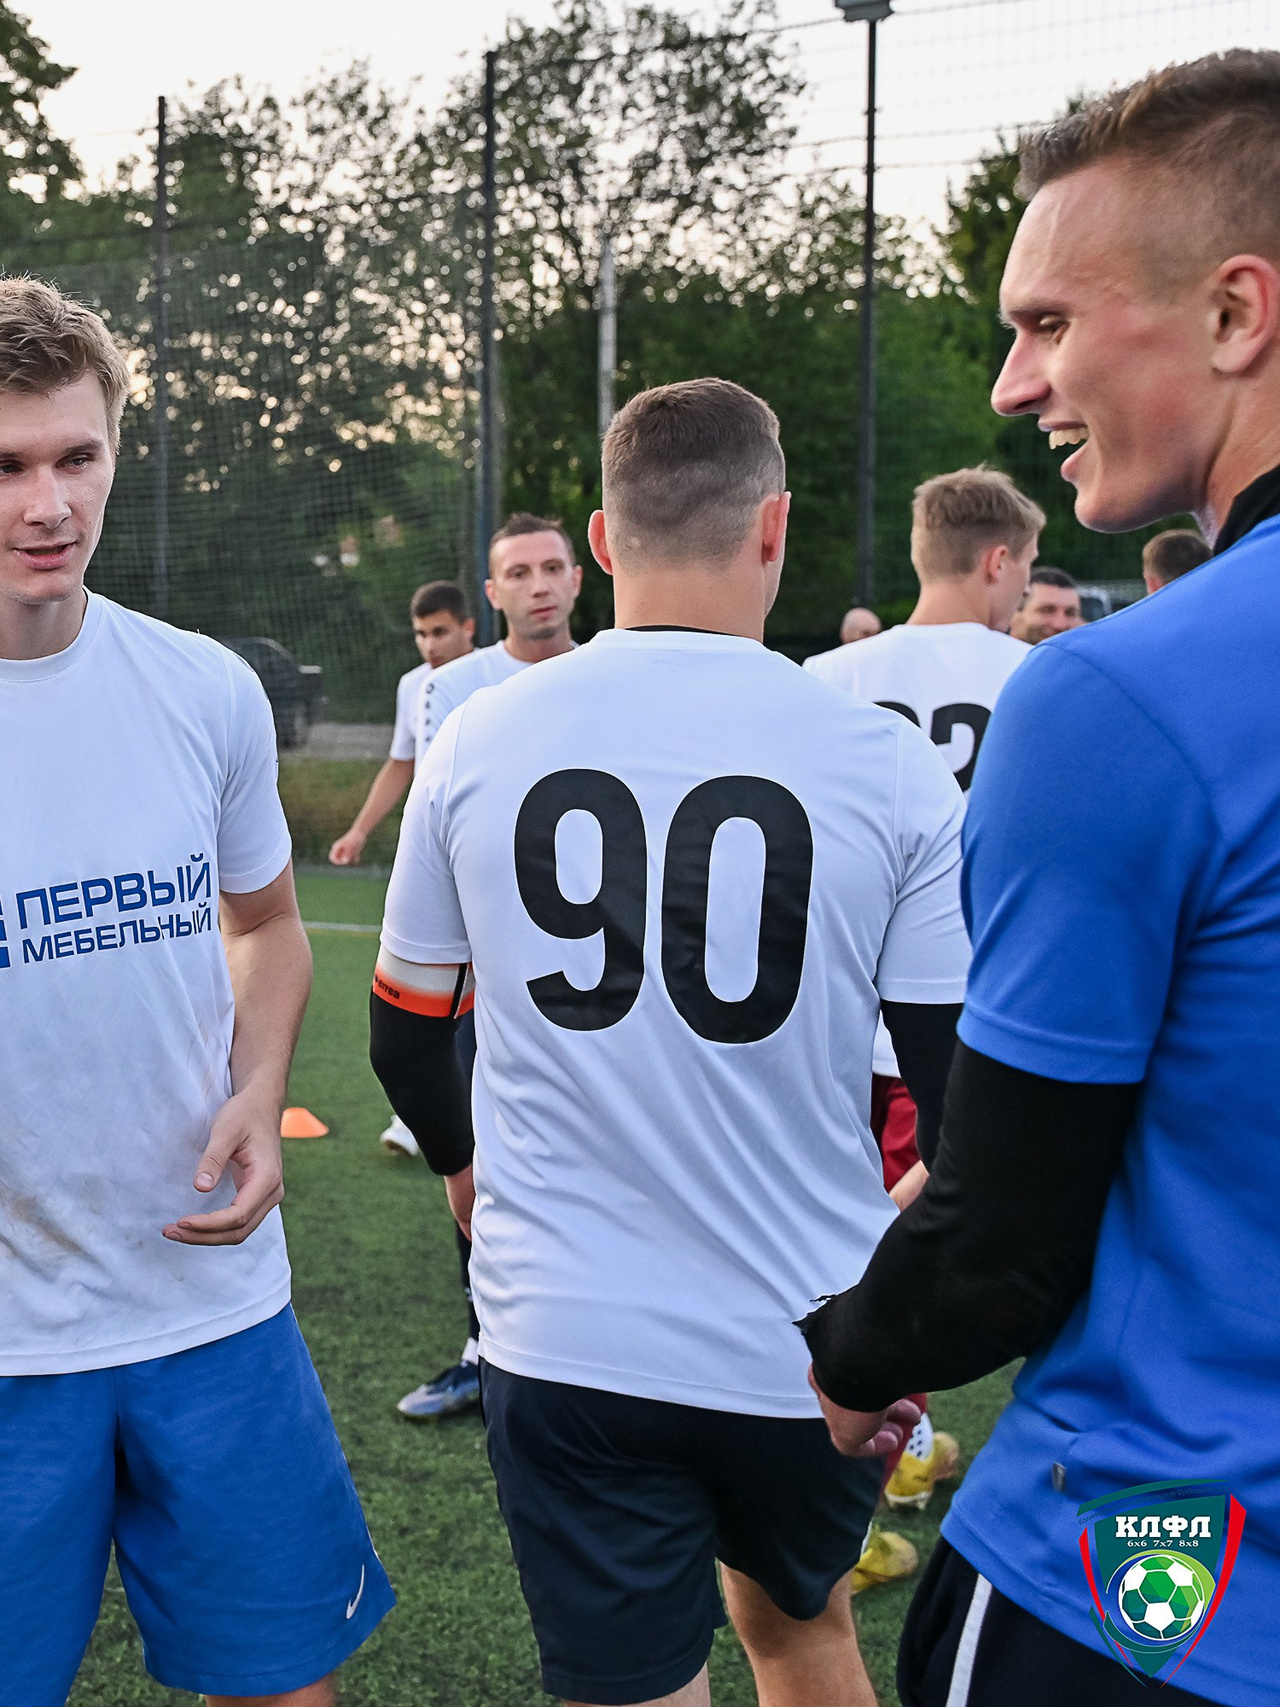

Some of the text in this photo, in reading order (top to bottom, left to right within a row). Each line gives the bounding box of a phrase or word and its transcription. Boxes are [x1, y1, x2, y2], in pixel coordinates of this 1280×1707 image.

[872, 701, 992, 793] 2
[16, 852, 212, 930] ПЕРВЫЙ
[22, 901, 212, 964] МЕБЕЛЬНЫЙ
[514, 768, 813, 1044] 90
